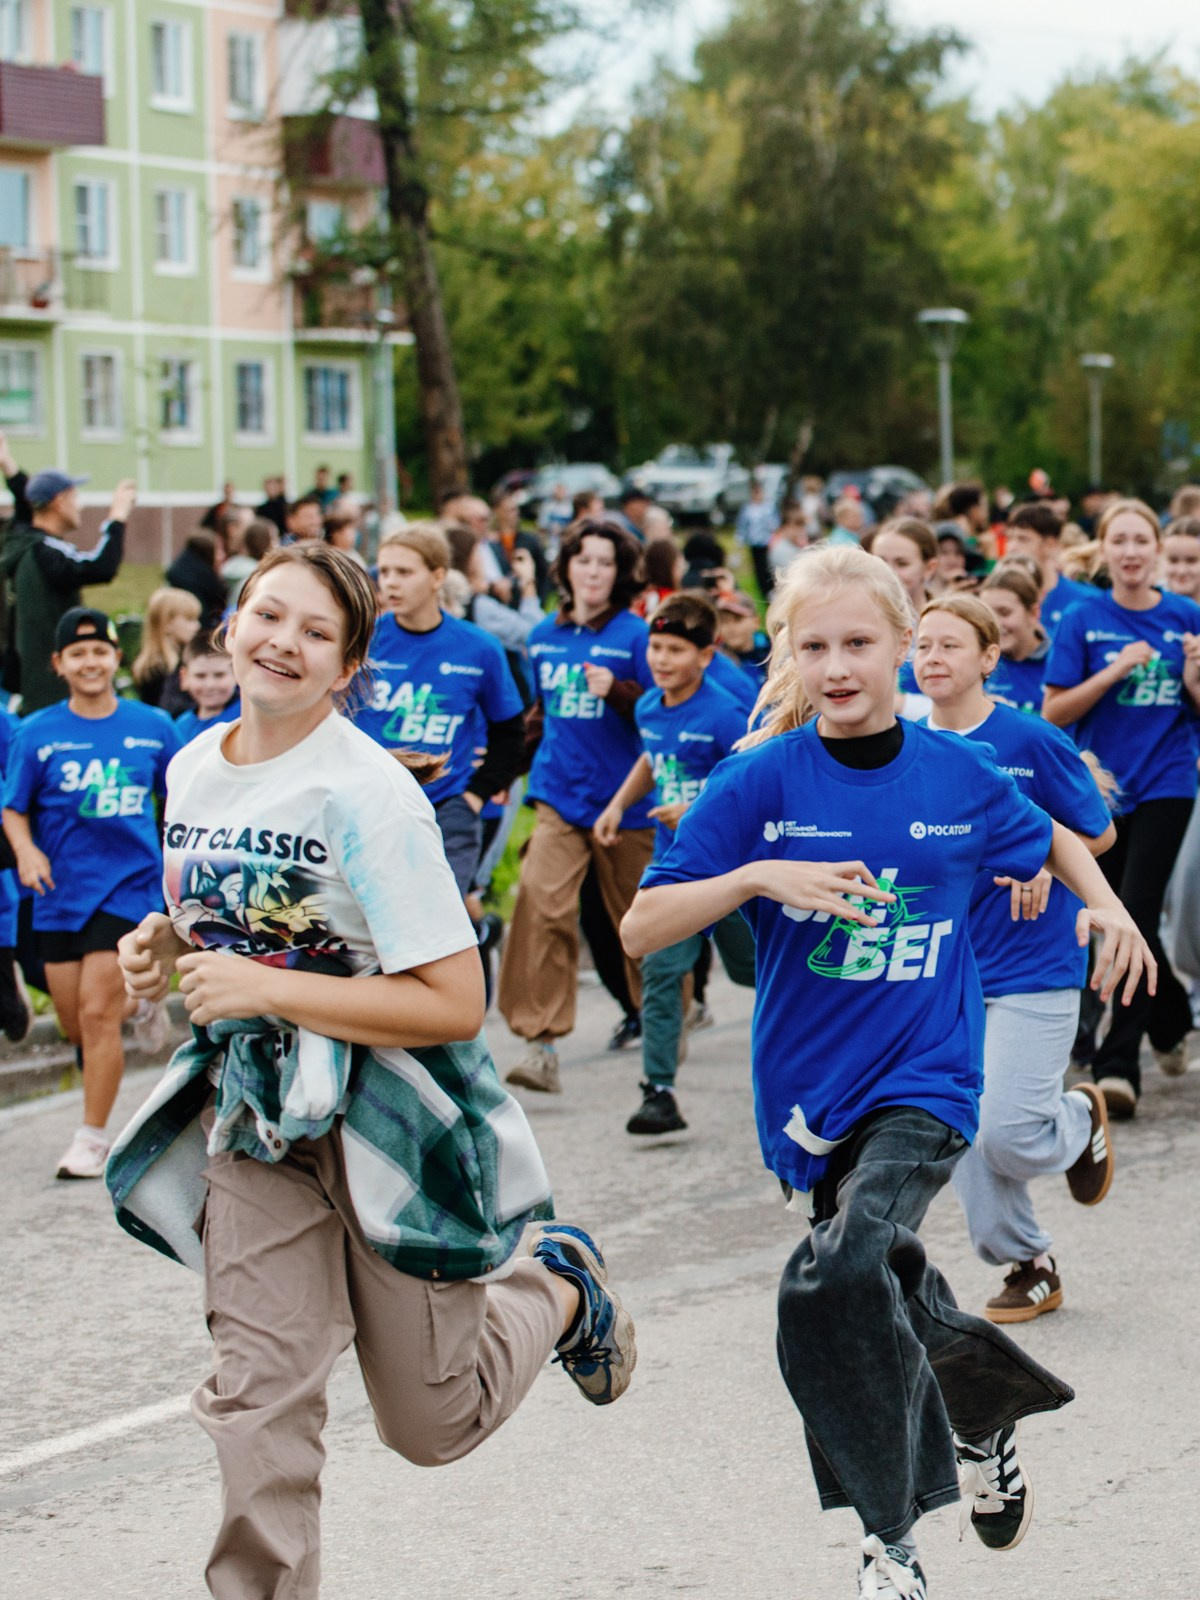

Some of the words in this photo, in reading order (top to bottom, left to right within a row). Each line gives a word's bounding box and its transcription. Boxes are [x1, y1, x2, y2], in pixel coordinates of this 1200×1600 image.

[399, 714, 465, 744] БЕГ
[59, 757, 121, 792] ЗА!
[96, 785, 149, 818] БЕГ
[208, 826, 329, 865] CLASSIC
[927, 823, 972, 836] РОСАТОМ
[840, 919, 953, 982] БЕГ
